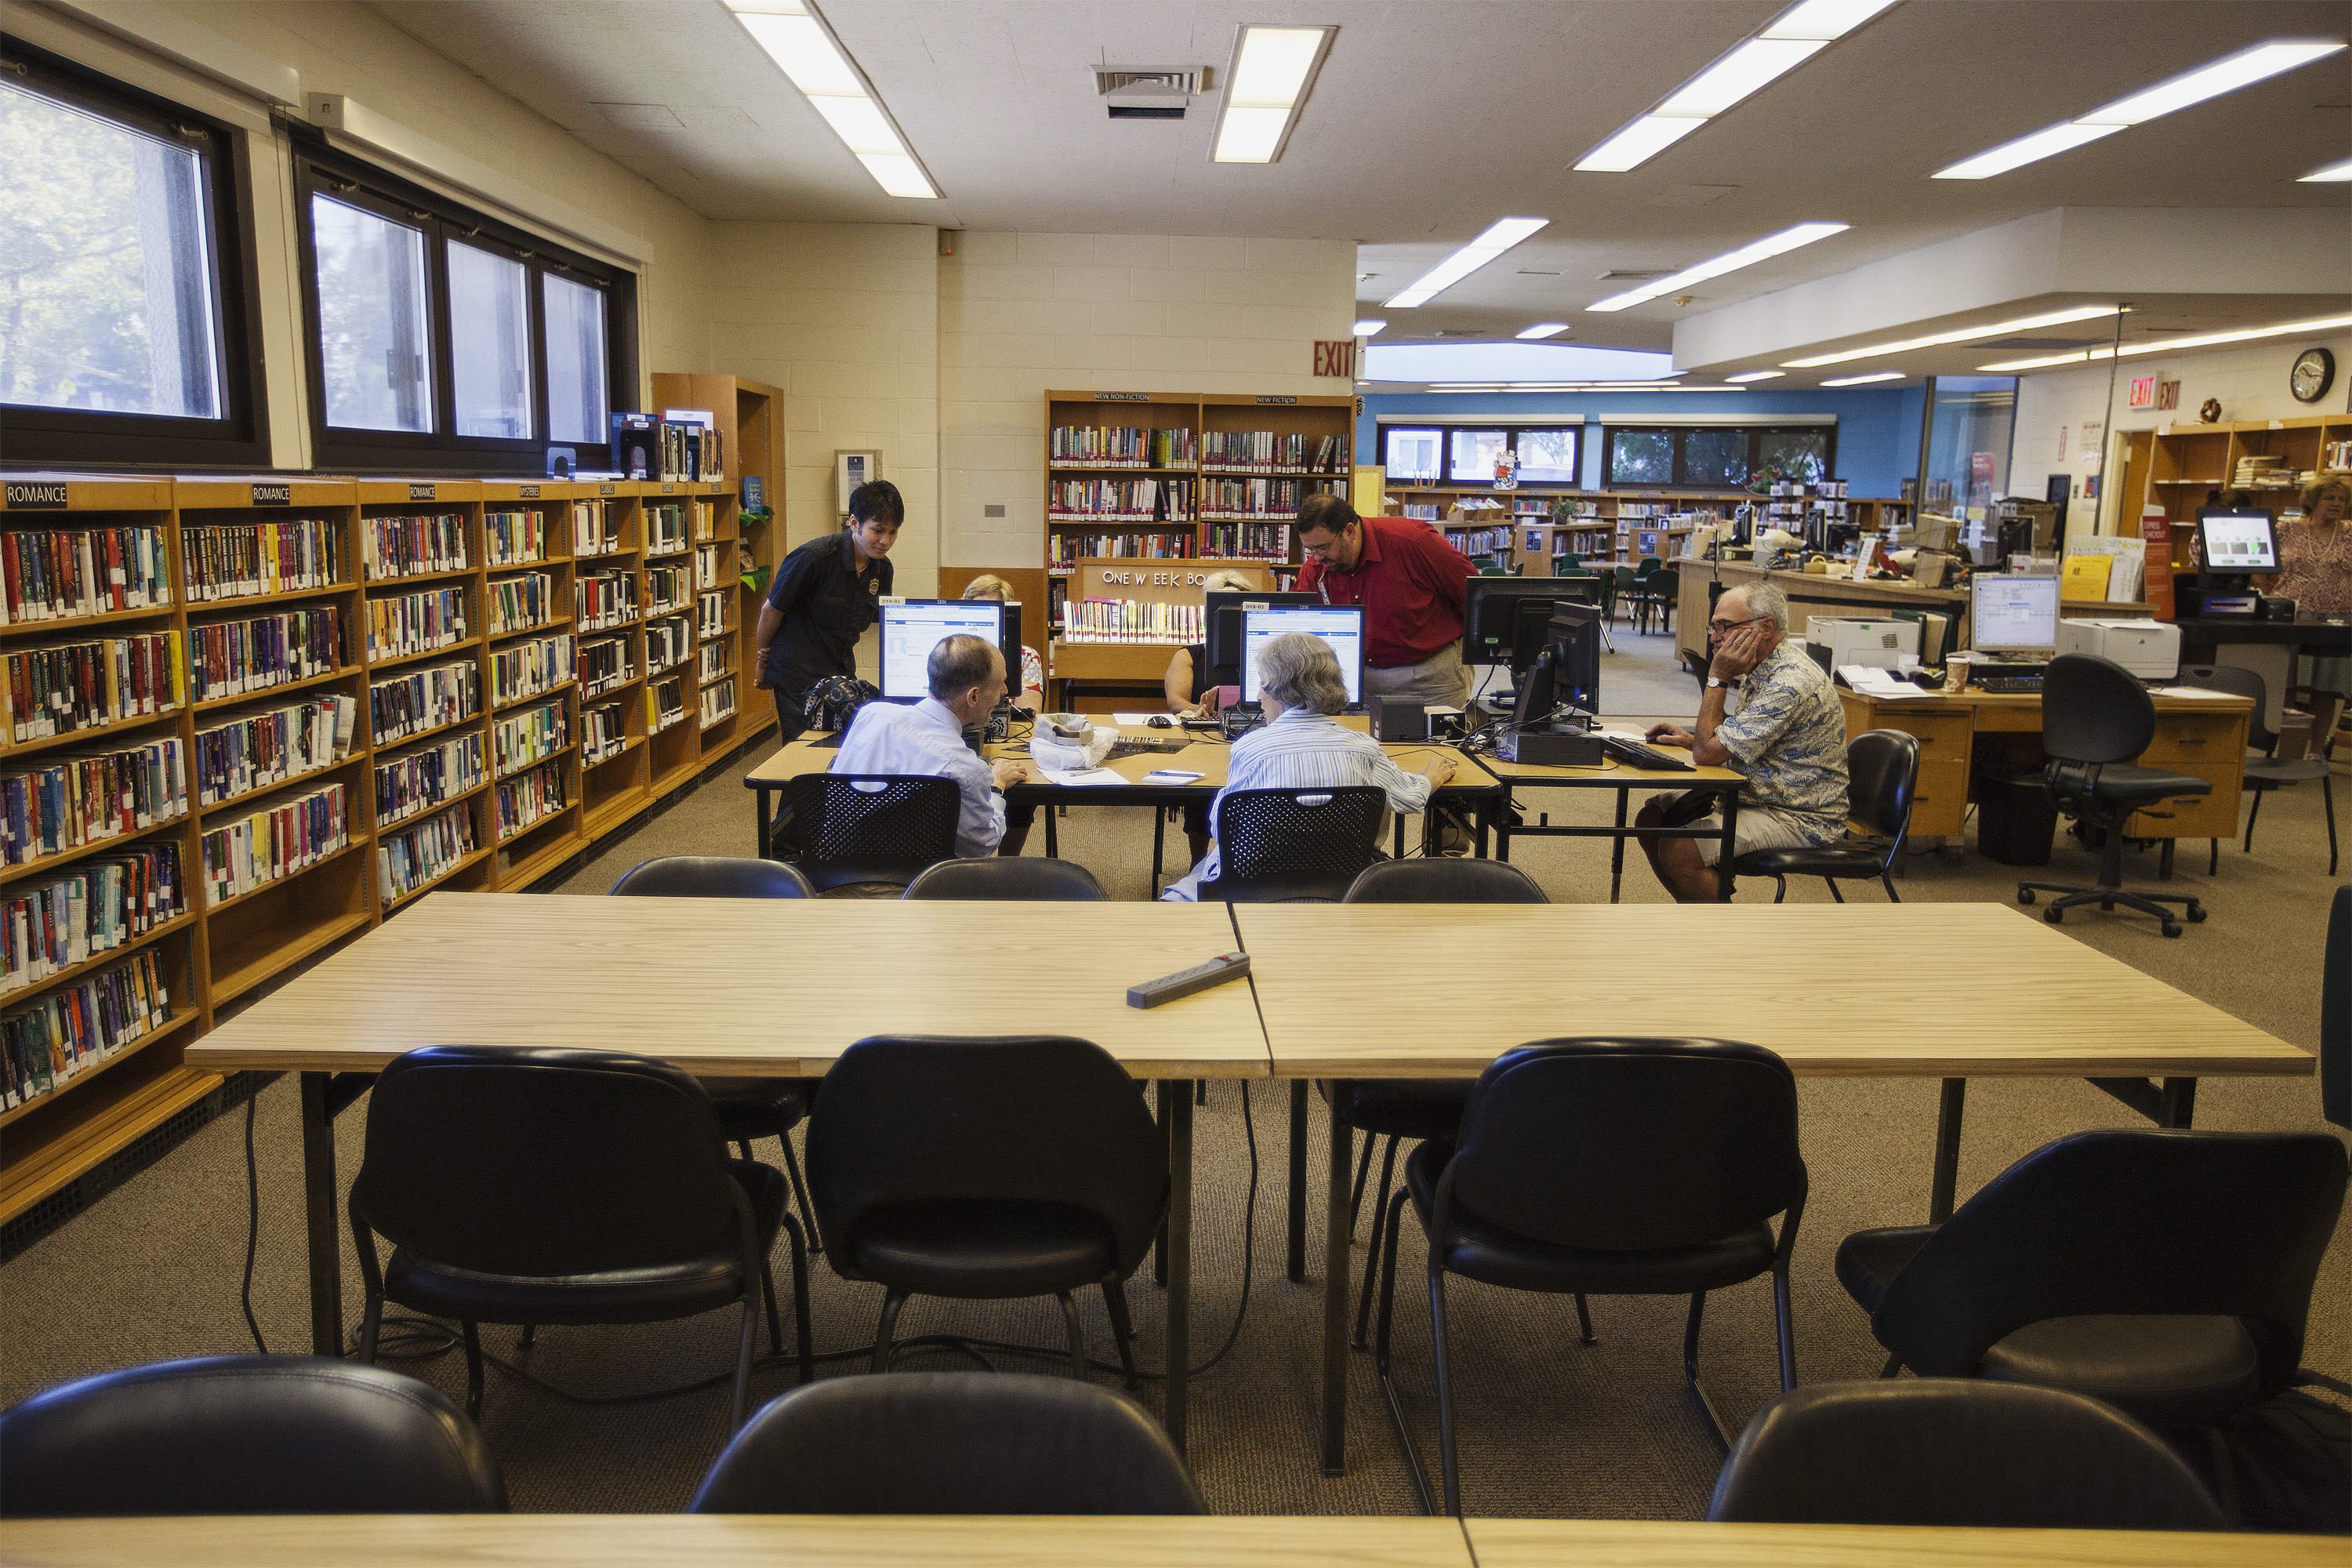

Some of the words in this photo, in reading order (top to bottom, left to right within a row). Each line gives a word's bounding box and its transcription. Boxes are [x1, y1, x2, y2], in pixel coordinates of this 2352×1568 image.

[1314, 341, 1352, 376] EXIT
[2130, 376, 2154, 406] EXIT
[2158, 380, 2180, 410] EXIT
[7, 485, 67, 503] ROMANCE
[253, 487, 290, 502] ROMANCE
[410, 486, 435, 498] ROMANCE
[520, 487, 539, 496] MYSTERIES
[1102, 571, 1130, 585] ONE
[1187, 572, 1207, 586] BO
